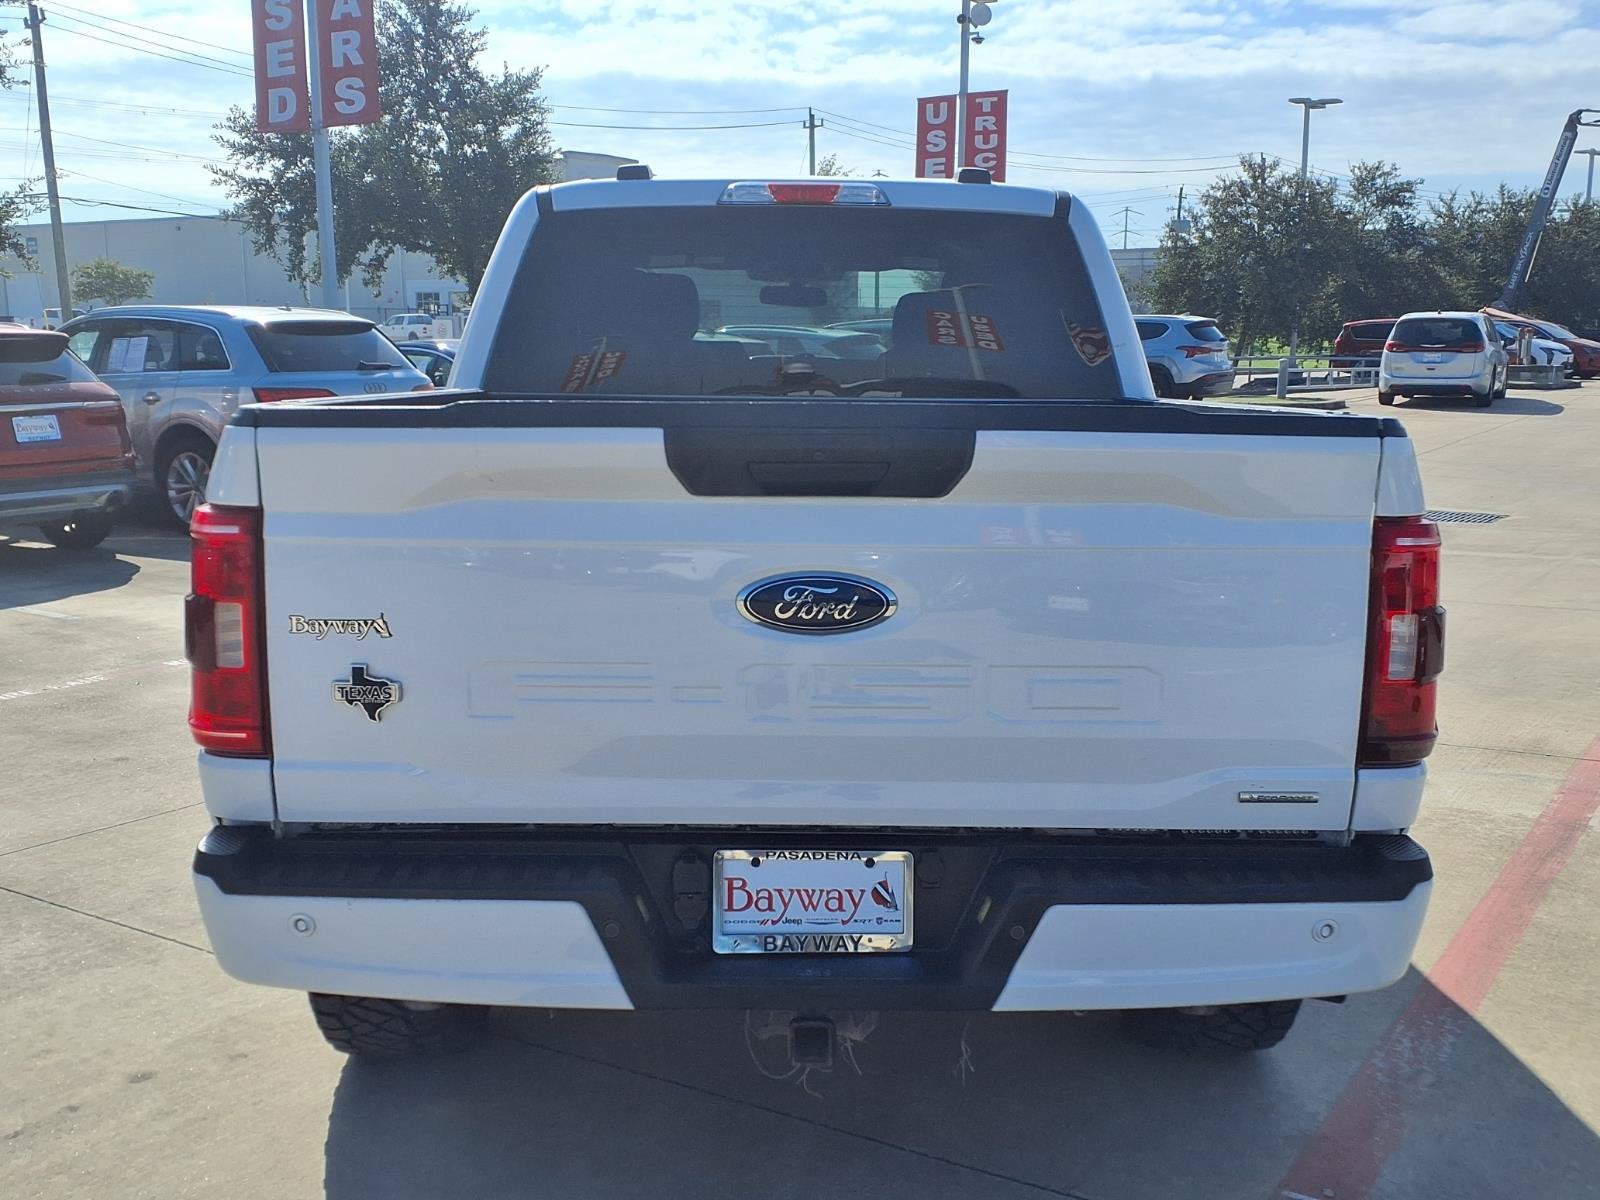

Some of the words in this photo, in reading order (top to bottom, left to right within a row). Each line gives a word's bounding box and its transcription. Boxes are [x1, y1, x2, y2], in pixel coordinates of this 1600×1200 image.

[974, 96, 998, 175] TRUC
[774, 585, 859, 620] Ford
[288, 614, 373, 640] Bayway
[336, 685, 392, 699] TEXAS
[765, 851, 862, 860] PASADENA
[723, 877, 866, 926] Bayway
[781, 917, 802, 925] Jeep
[763, 935, 863, 952] BAYWAY
